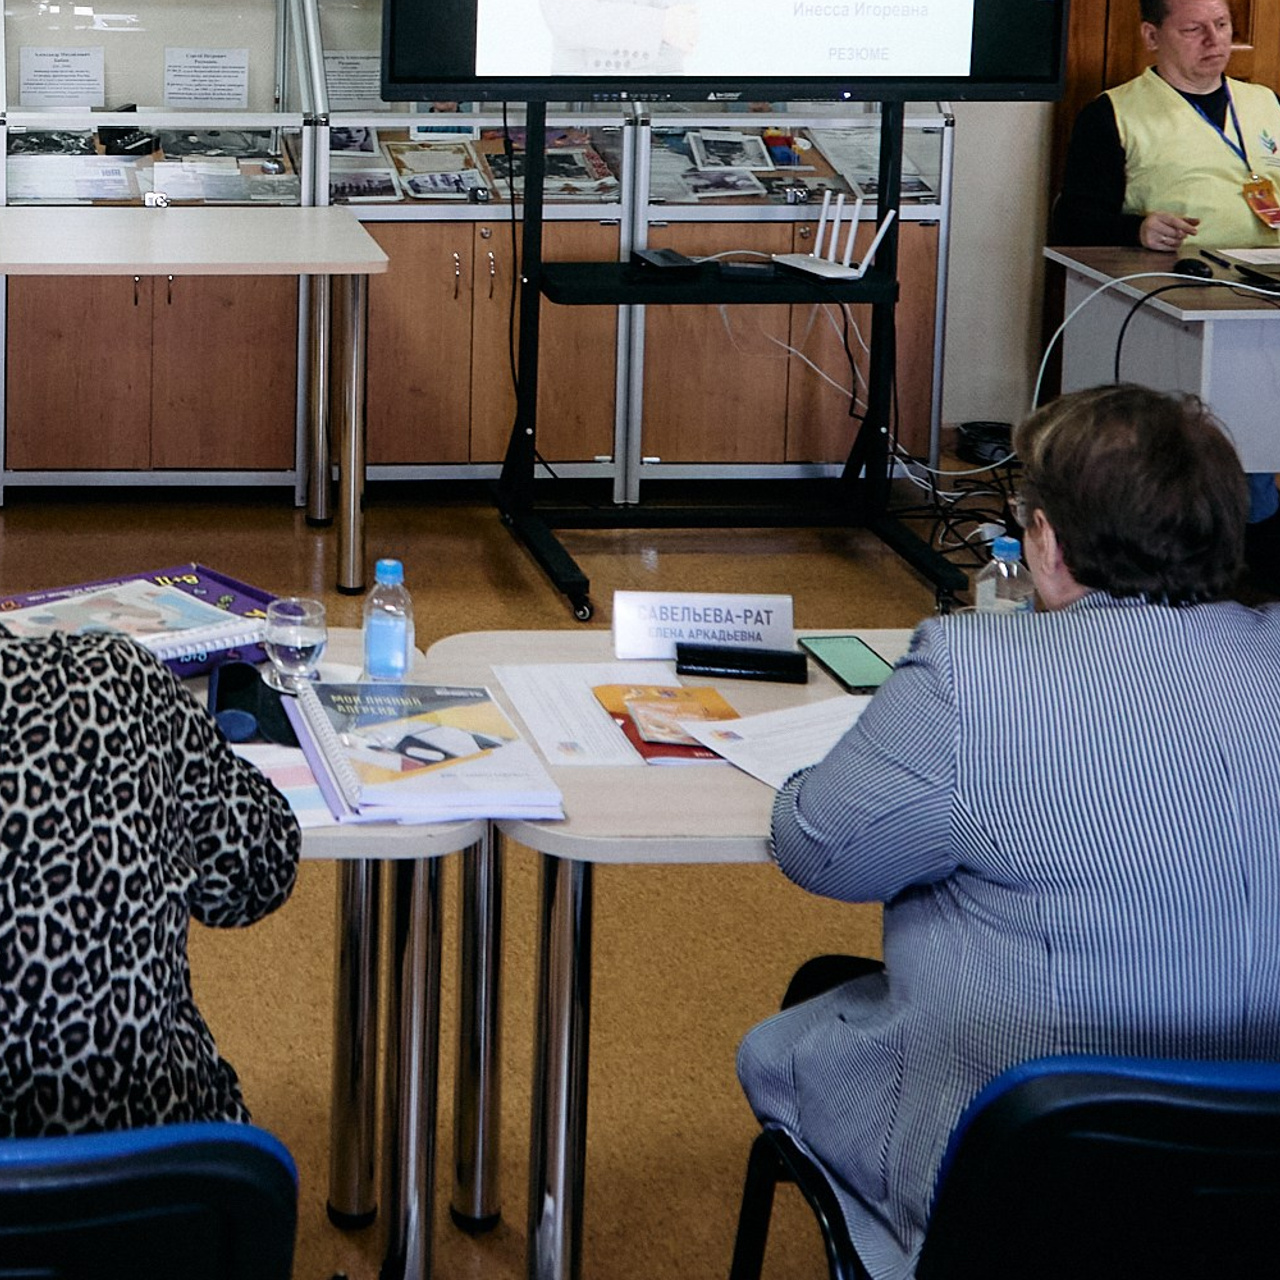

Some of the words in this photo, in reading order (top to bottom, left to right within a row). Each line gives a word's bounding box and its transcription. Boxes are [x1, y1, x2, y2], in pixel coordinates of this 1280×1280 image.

[793, 2, 849, 17] Инесса
[854, 2, 928, 19] Игоревна
[828, 47, 890, 61] РЕЗЮМЕ
[649, 627, 685, 639] ЕЛЕНА
[688, 628, 763, 642] АРКАДЬЕВНА
